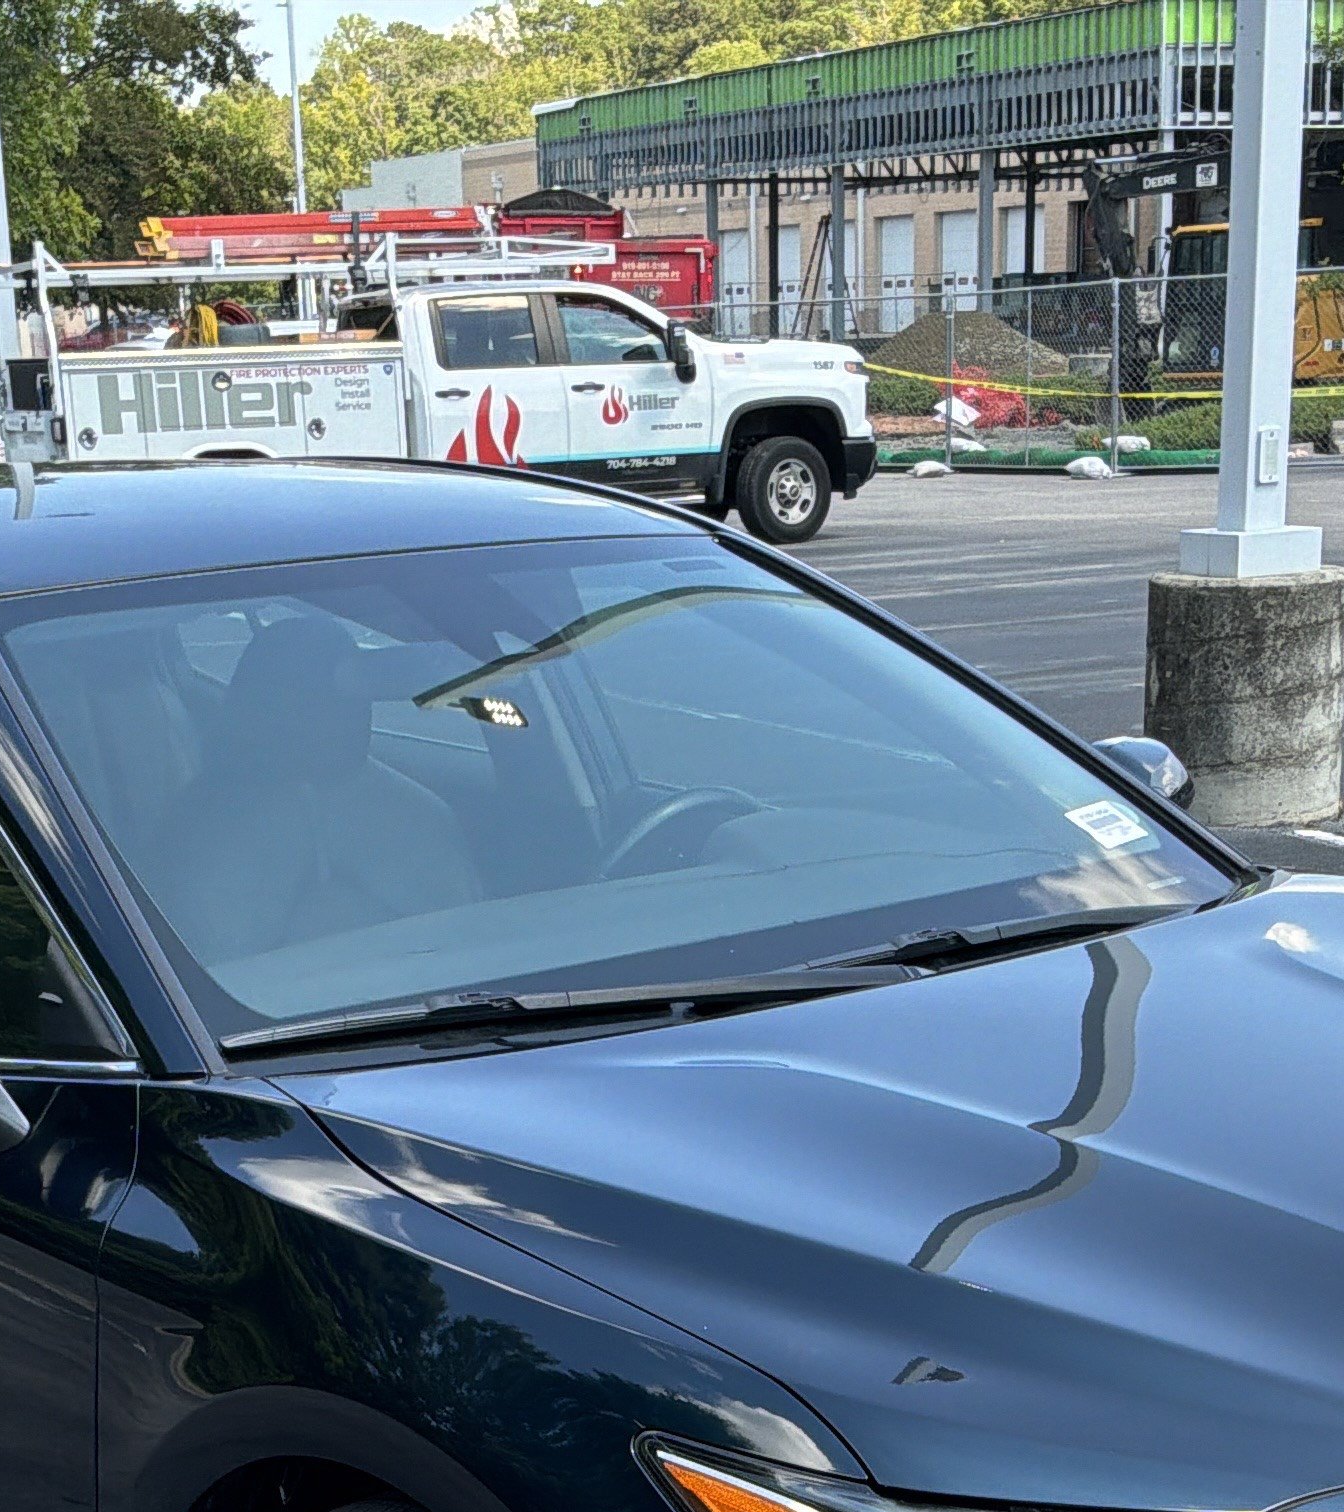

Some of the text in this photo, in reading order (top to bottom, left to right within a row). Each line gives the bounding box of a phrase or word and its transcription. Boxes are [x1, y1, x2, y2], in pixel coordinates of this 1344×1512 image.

[1143, 173, 1177, 189] DEERE
[256, 366, 321, 377] PROTECTION
[324, 365, 369, 376] EXPERTS
[335, 377, 369, 388] Design
[341, 388, 370, 399] Install
[97, 370, 313, 434] Hiller
[335, 401, 371, 411] Service
[628, 394, 679, 411] Hiller
